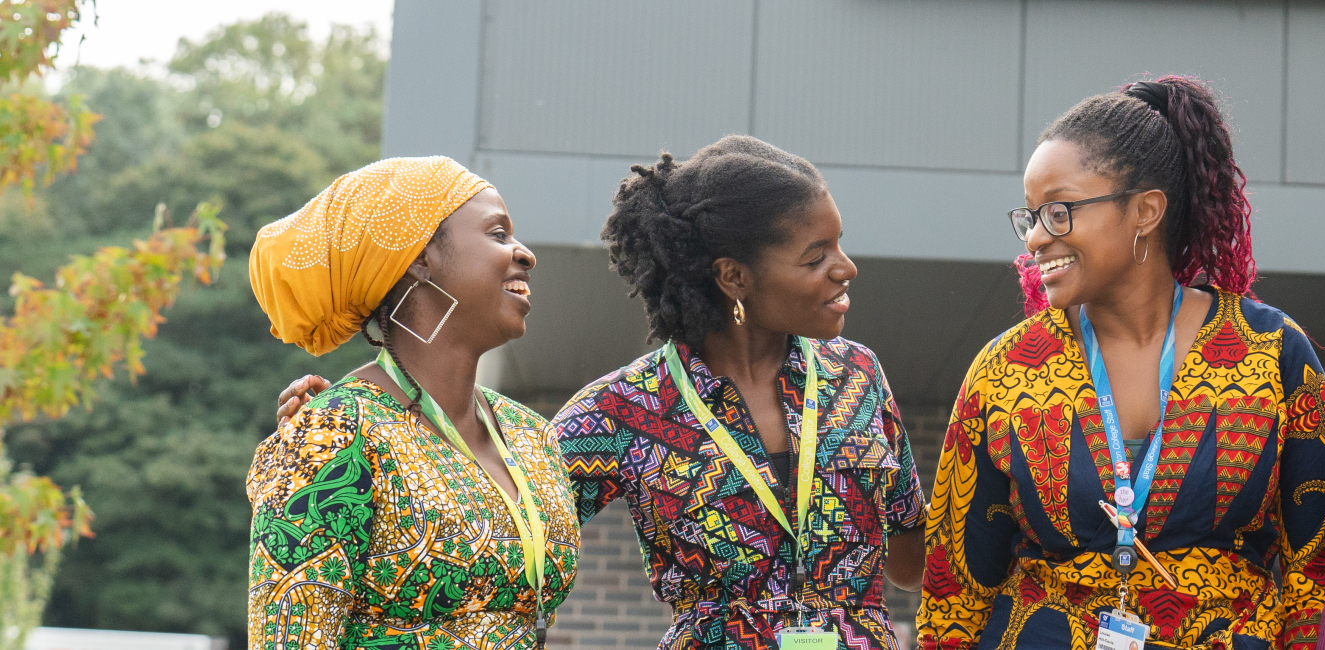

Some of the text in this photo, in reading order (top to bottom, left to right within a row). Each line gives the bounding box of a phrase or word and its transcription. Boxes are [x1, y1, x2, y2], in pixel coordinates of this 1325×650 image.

[1104, 409, 1114, 424] Staff
[1110, 425, 1120, 449] College
[801, 418, 814, 482] College Visitor
[720, 436, 766, 491] College Visitor
[1142, 463, 1154, 480] Staff
[514, 511, 528, 540] Visitor
[1121, 624, 1135, 633] Staff
